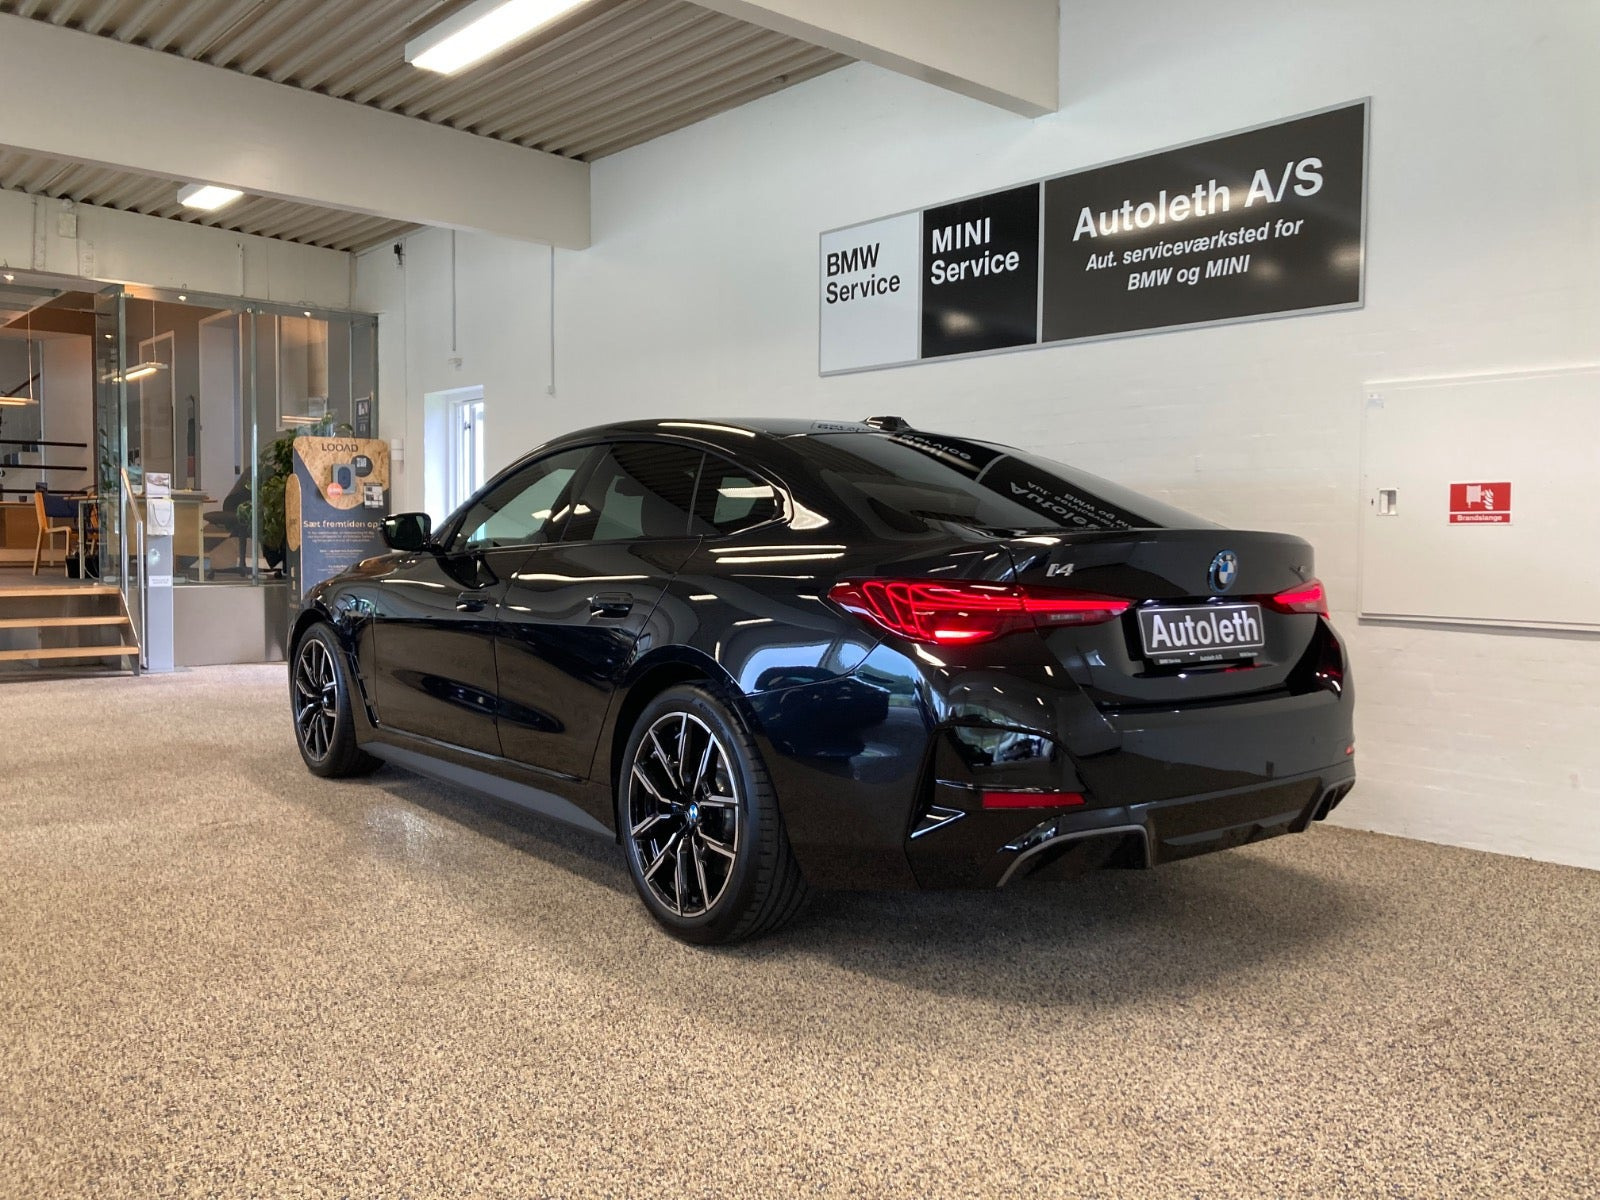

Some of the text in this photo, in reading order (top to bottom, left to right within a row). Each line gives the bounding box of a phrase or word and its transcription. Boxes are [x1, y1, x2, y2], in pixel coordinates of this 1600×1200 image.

[1072, 157, 1324, 242] Autoleth A/S
[932, 216, 991, 255] MINI
[1085, 217, 1304, 272] Aut. serviceværksted for
[826, 242, 880, 277] BMW
[930, 250, 1020, 286] Service
[1127, 254, 1251, 291] BMW og MINI
[825, 273, 901, 305] Service
[1457, 514, 1503, 522] Brandslange
[1151, 610, 1259, 649] Autoleth
